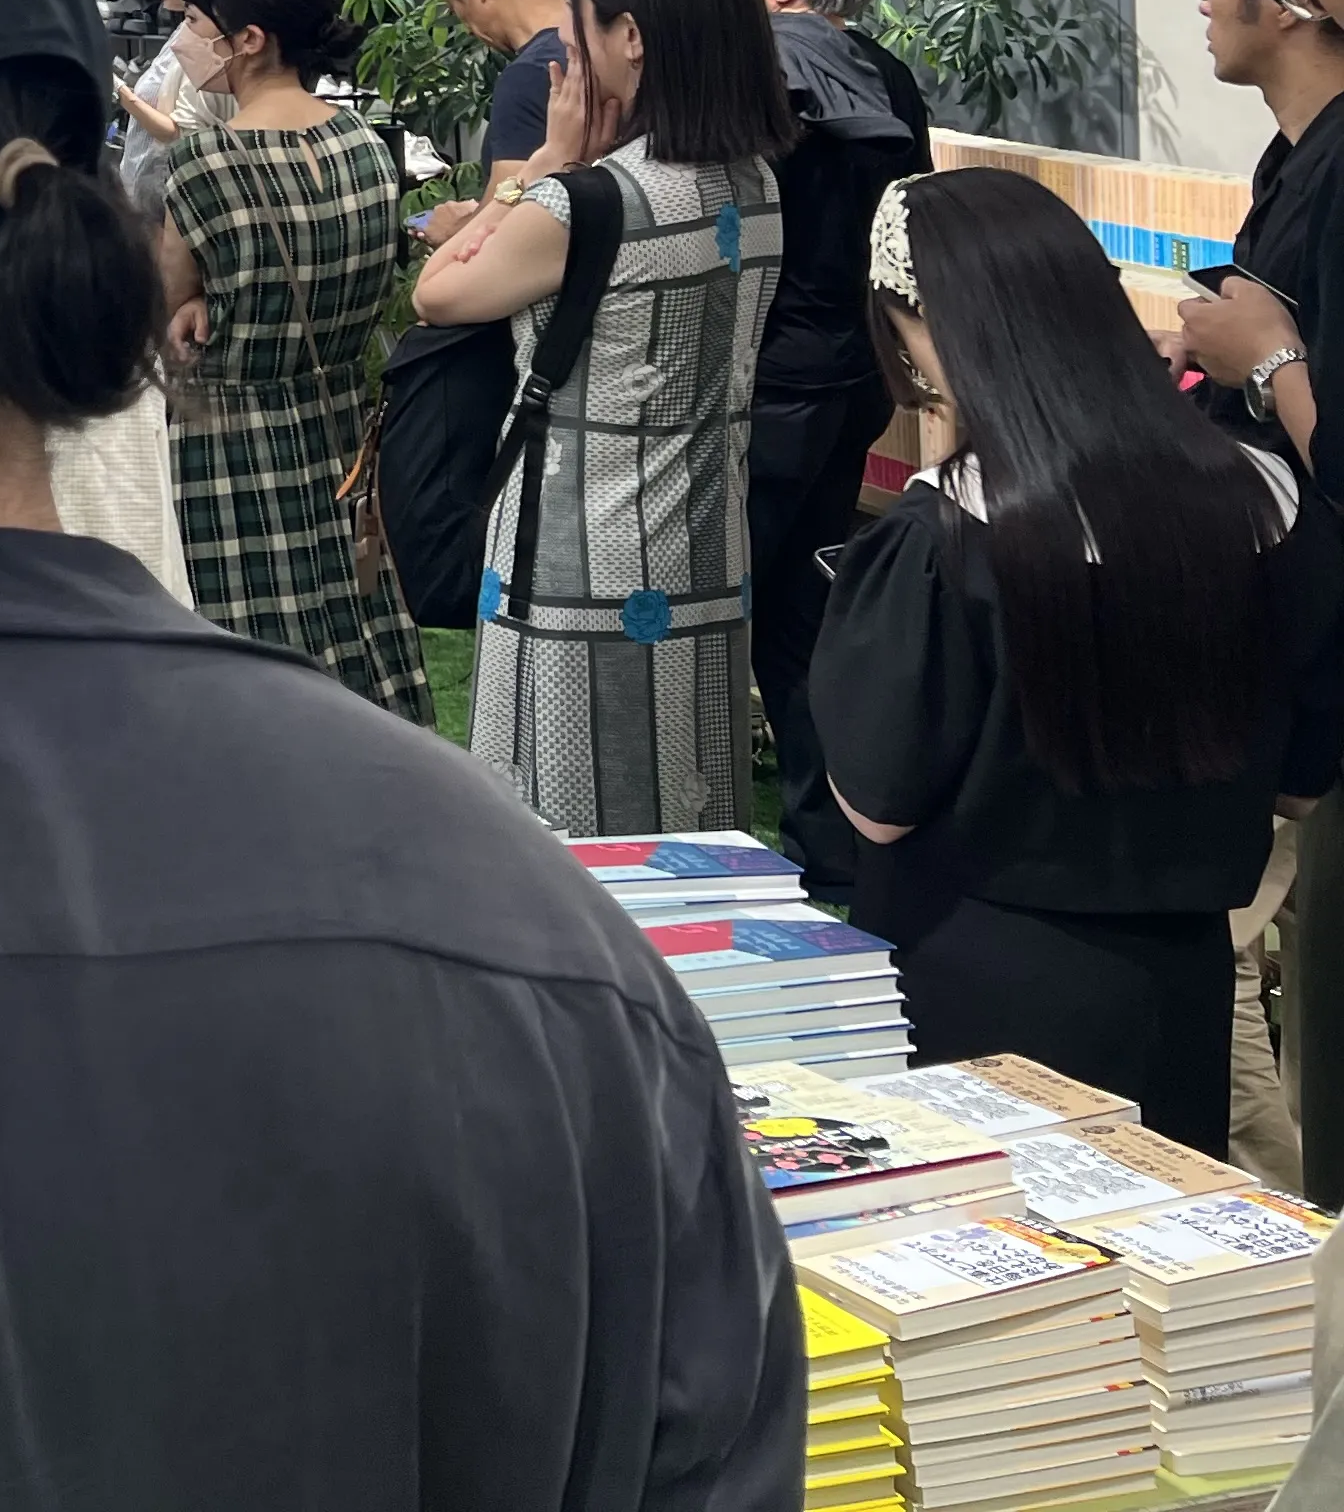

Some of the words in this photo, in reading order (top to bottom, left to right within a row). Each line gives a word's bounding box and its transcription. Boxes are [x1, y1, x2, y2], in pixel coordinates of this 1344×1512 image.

[1235, 1232, 1292, 1255] 毎日を
[957, 1240, 1049, 1276] 終えたくない
[996, 1243, 1064, 1271] あなたへ
[973, 1259, 1029, 1281] 毎日を
